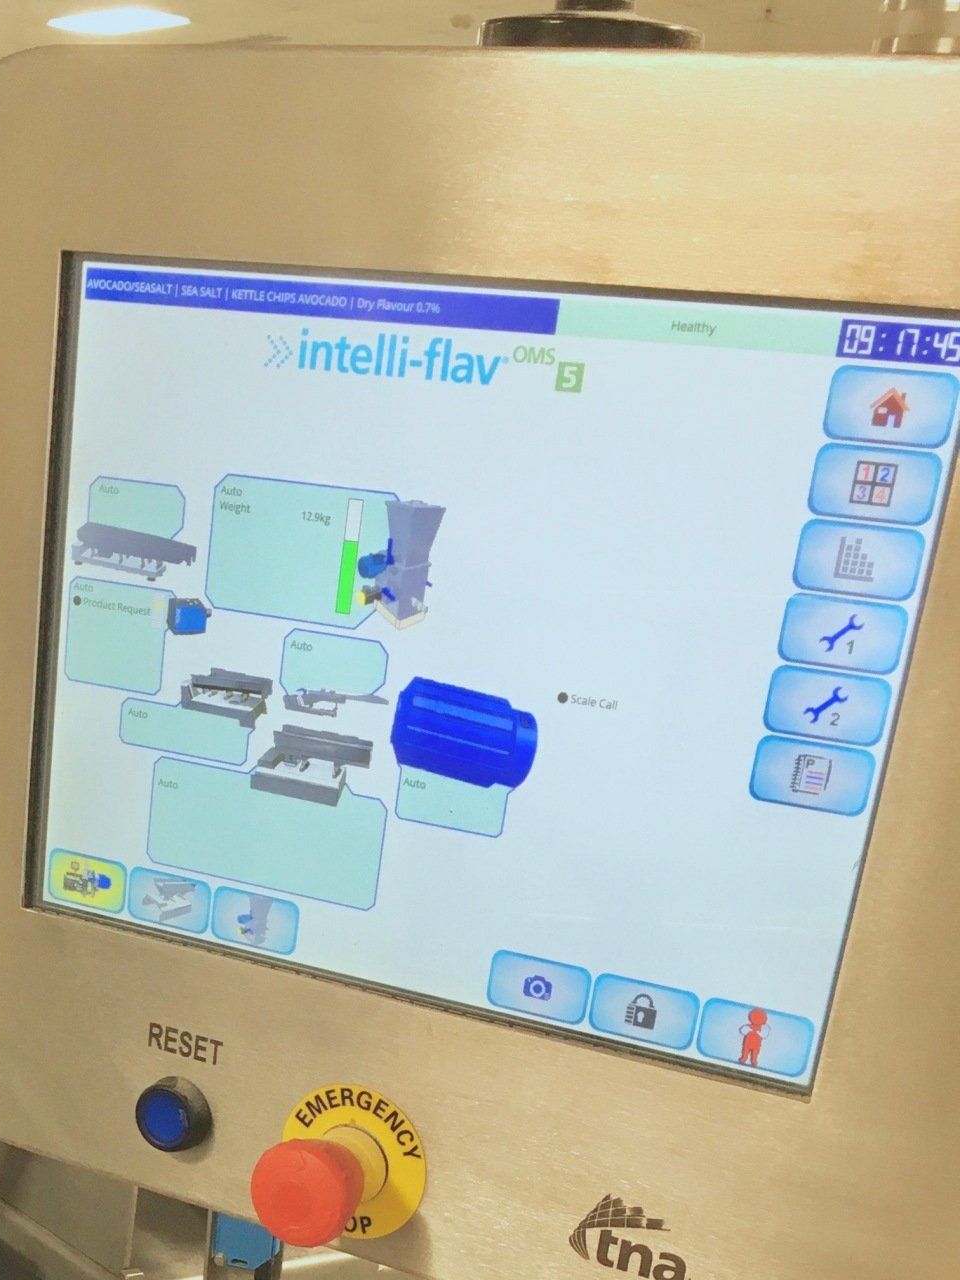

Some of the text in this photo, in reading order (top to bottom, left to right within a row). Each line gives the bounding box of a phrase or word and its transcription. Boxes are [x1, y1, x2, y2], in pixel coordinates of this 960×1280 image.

[86, 278, 441, 314] AVOCADO/SEASALT SEA SALT KETTLE CHIPS AVOCADO Dry Flavour 0.7%
[670, 319, 717, 337] Healthy
[297, 328, 580, 391] intelli-flav OMS 5
[862, 463, 891, 483] 1 2
[98, 484, 120, 496] Auto
[221, 485, 243, 497] Auto
[856, 485, 885, 504] 3 4
[219, 500, 332, 526] Weight 12.9kg
[74, 581, 94, 593] Auto
[83, 596, 152, 617] Product Request
[290, 640, 313, 652] Auto
[845, 639, 855, 655] 1
[570, 693, 619, 710] Scale Call
[127, 708, 149, 720] Auto
[830, 711, 841, 728] 2
[157, 778, 179, 791] Auto
[403, 777, 427, 790] Auto
[148, 1022, 224, 1065] RESET
[294, 1087, 422, 1162] EMERGENCY
[344, 1214, 373, 1235] OP
